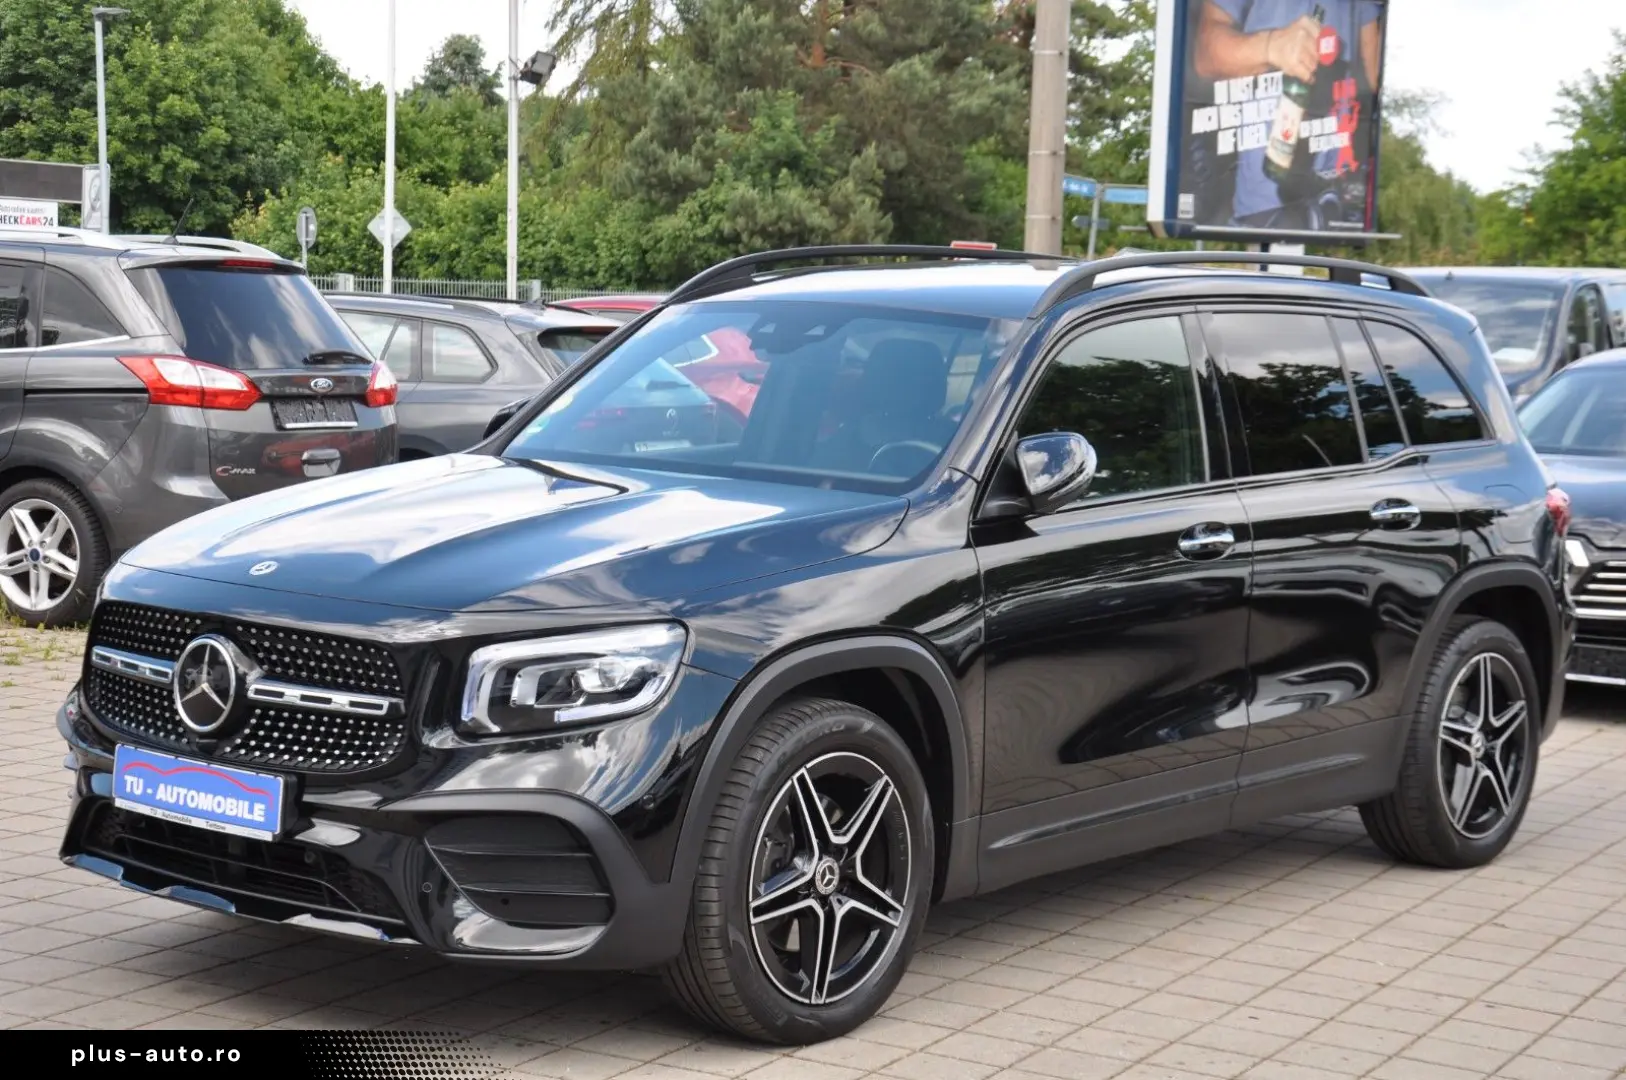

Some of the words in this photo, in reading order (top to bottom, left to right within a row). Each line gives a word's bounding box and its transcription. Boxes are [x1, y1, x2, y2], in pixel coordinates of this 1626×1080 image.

[124, 774, 144, 796] TU
[156, 783, 266, 822] AUTOMOBILE
[162, 811, 192, 824] Automobile
